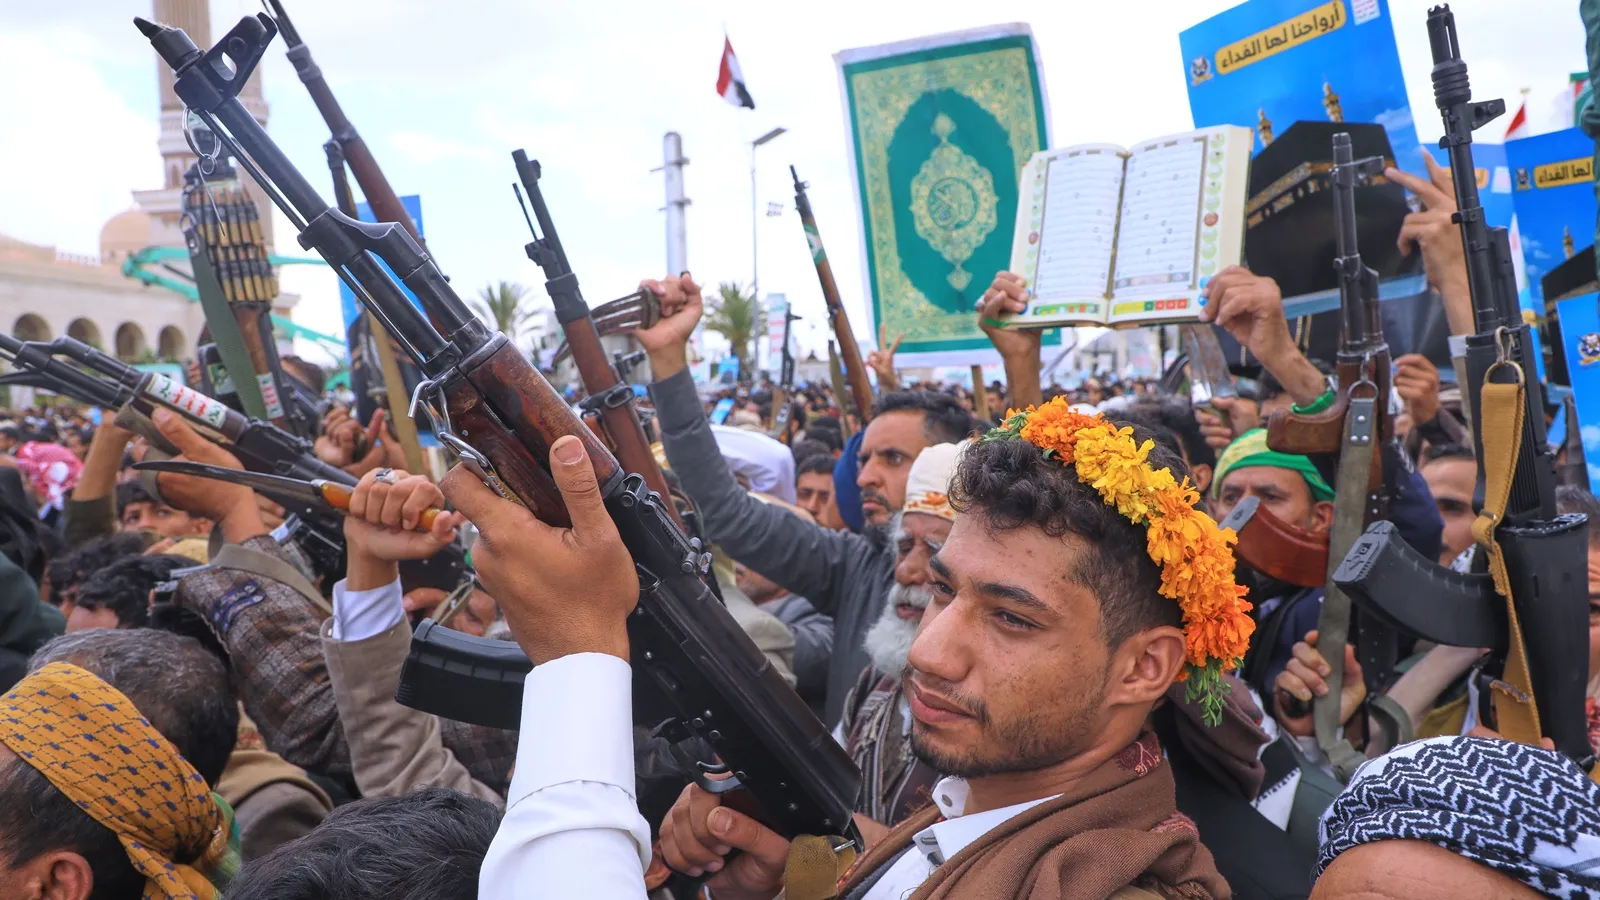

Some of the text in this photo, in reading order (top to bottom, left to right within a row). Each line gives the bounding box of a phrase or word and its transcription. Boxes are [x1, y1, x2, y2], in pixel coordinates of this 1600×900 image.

[1291, 3, 1340, 39] أرواحنا
[1265, 28, 1288, 50] لها
[1222, 39, 1261, 68] الفداء
[1539, 160, 1591, 183] لها الفداء
